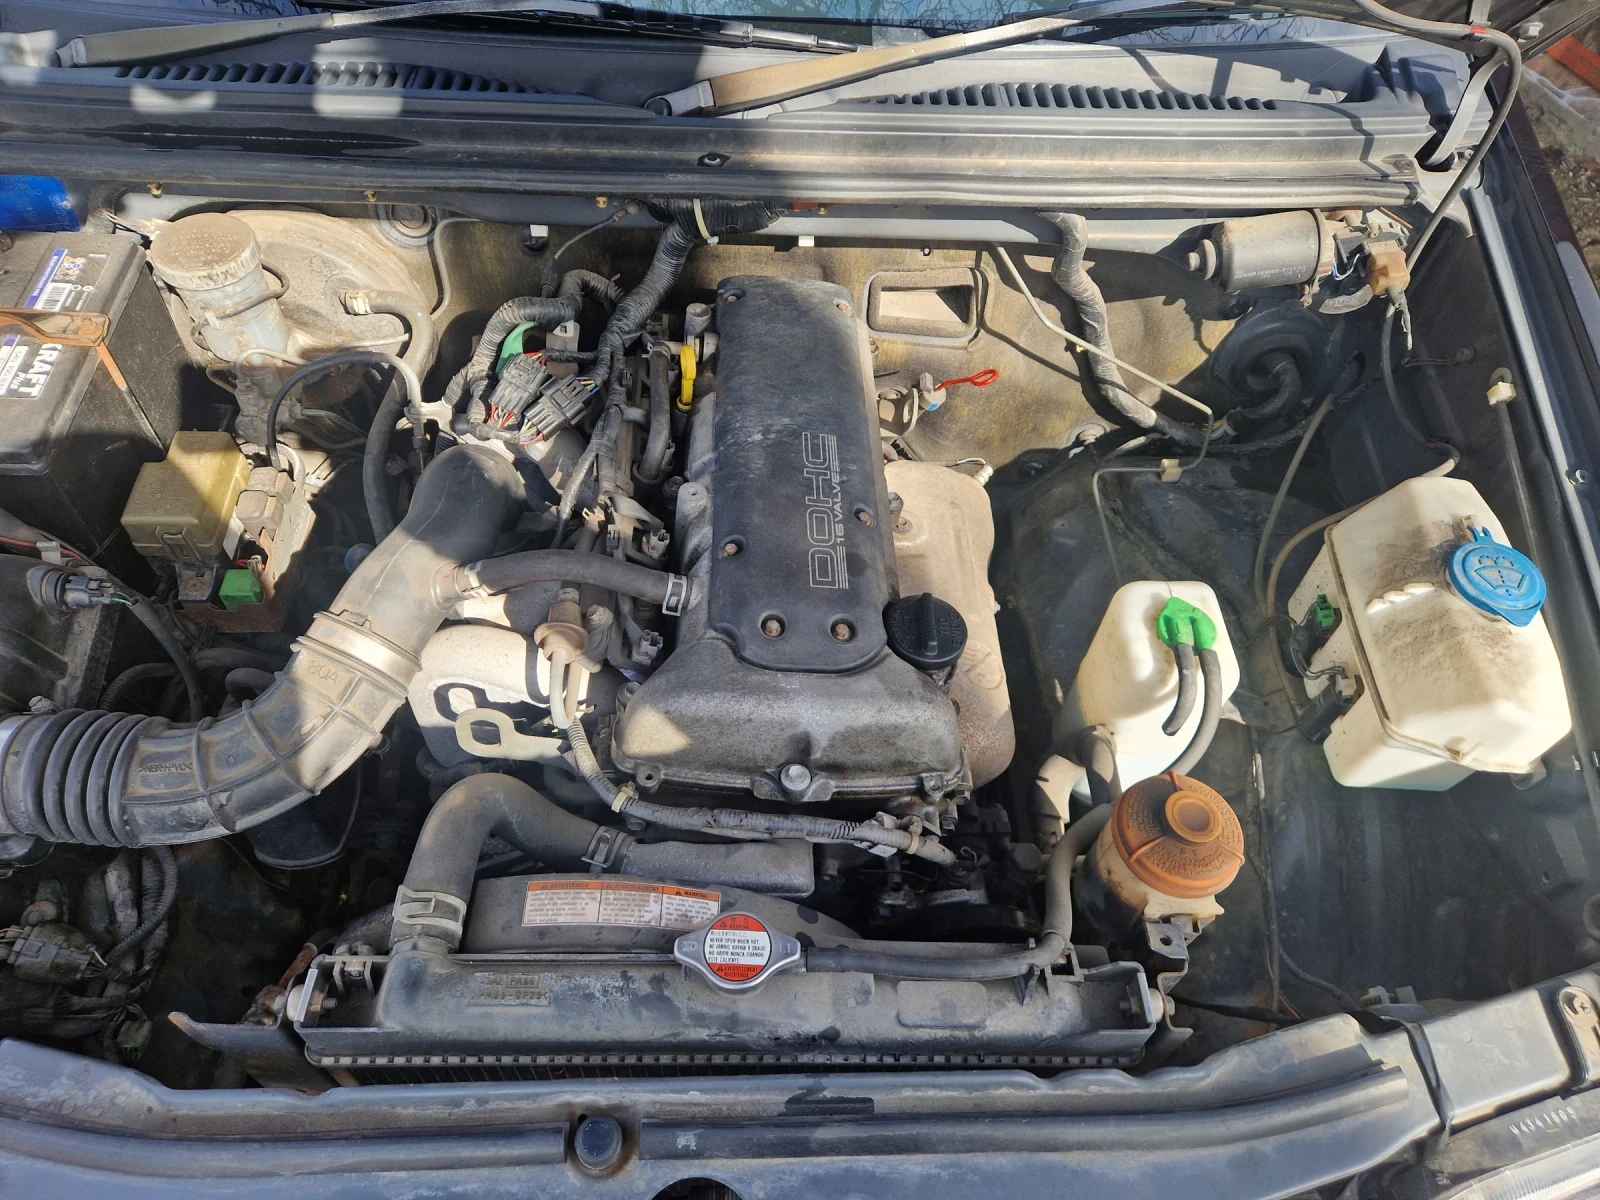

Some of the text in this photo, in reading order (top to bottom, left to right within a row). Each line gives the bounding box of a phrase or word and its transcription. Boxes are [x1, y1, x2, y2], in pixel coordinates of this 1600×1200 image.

[802, 432, 838, 589] DOHC
[308, 659, 340, 685] 80A
[684, 890, 707, 899] WARNING
